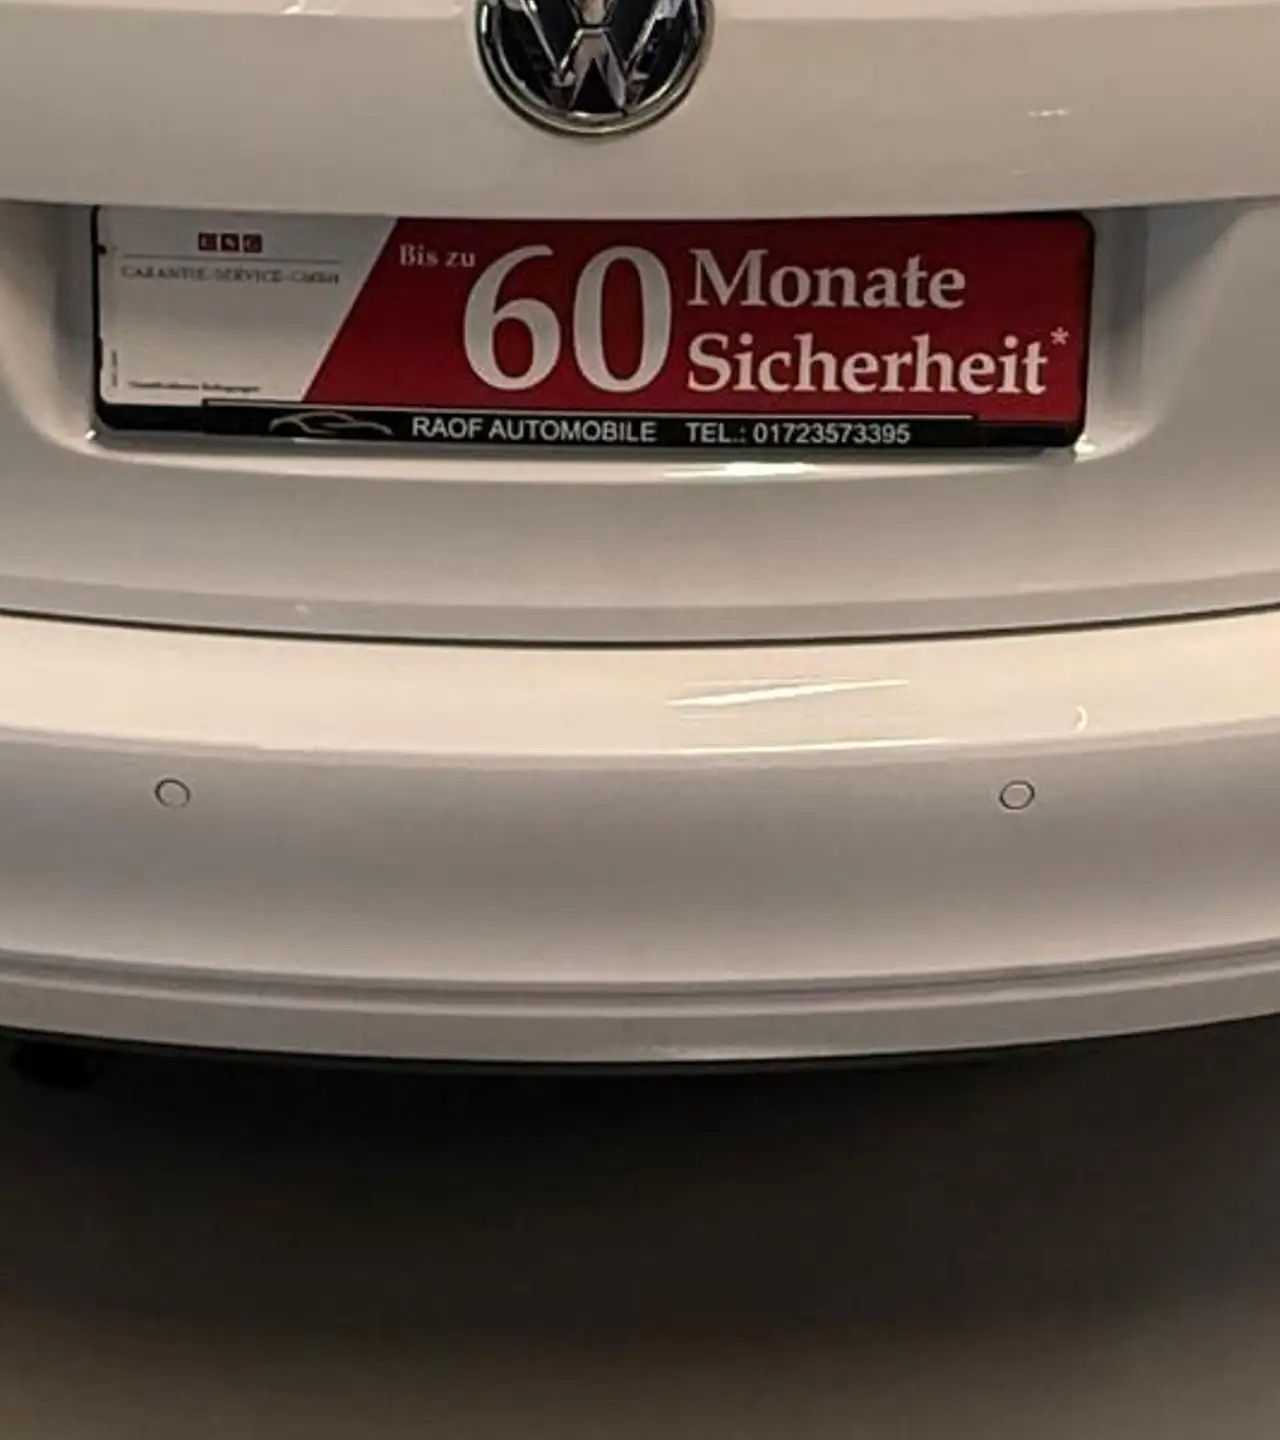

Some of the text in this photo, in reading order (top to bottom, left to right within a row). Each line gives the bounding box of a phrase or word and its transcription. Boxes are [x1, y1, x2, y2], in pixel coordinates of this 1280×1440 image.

[686, 248, 967, 309] Monate
[399, 243, 672, 393] Bis zu 60
[412, 416, 911, 446] RAOF AUTOMOBILE TEL.: 01723573395
